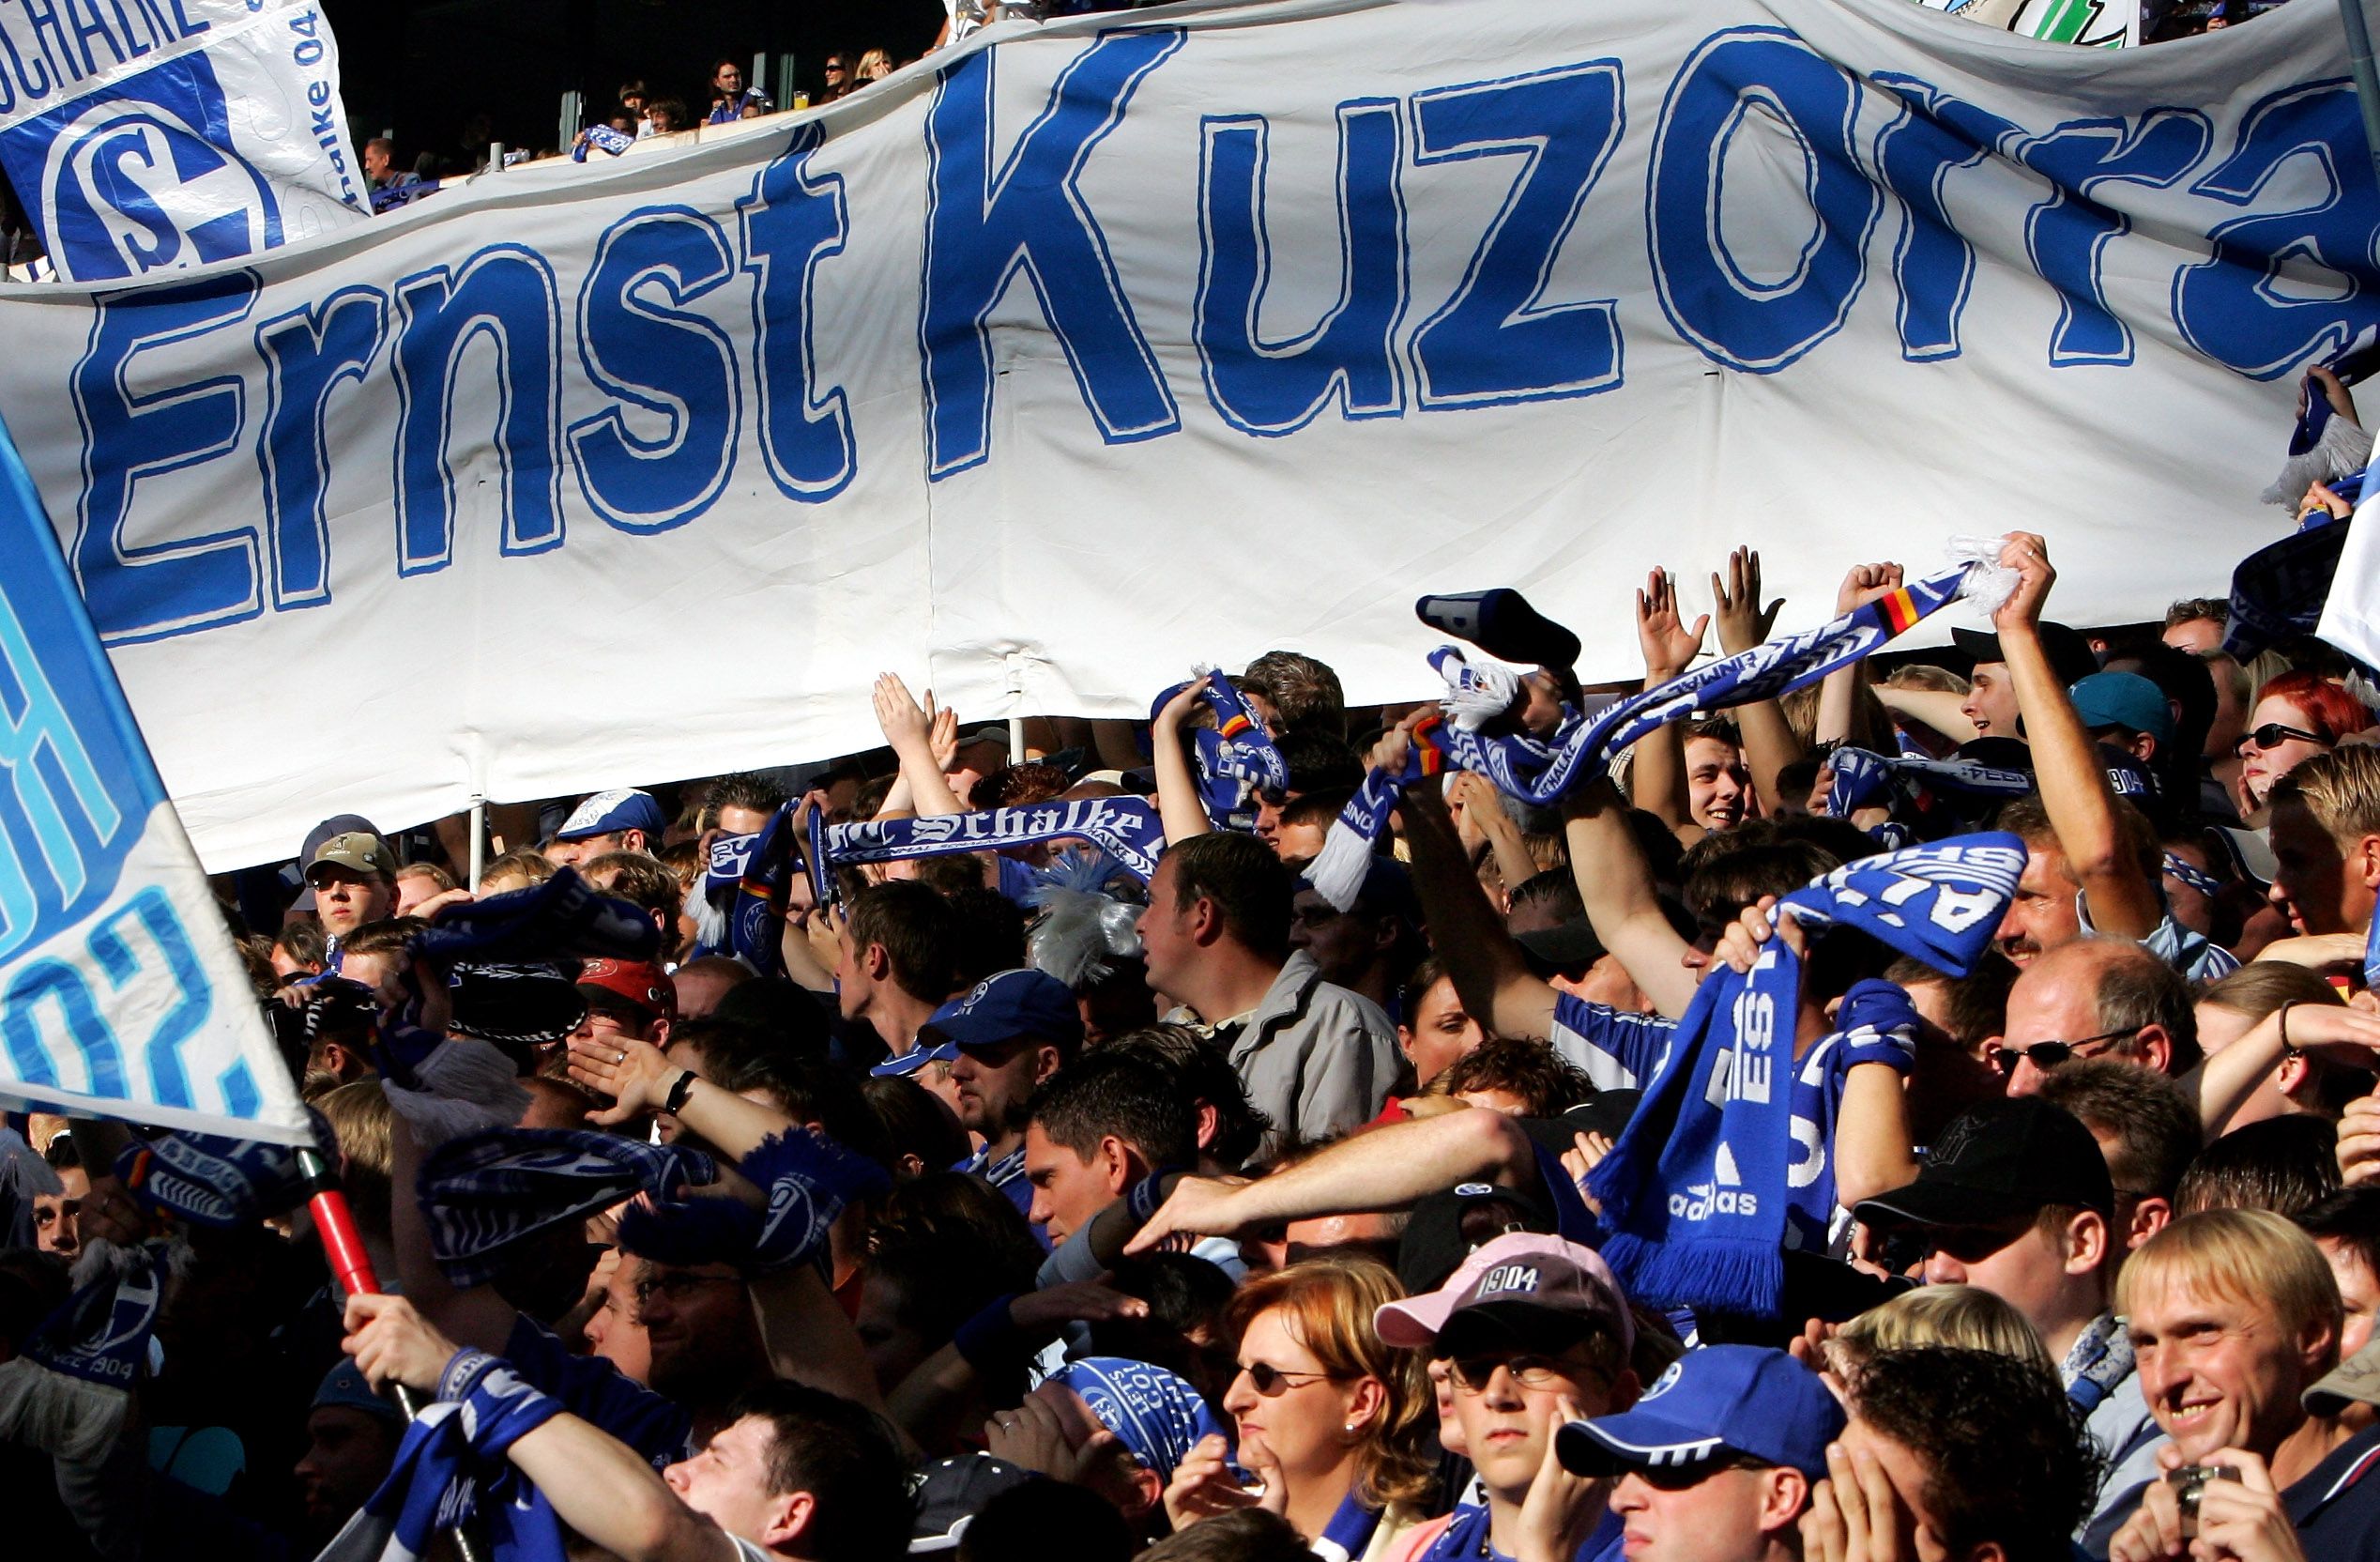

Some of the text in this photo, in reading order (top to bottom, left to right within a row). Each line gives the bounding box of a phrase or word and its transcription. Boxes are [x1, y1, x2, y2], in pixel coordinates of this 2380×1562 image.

[0, 0, 211, 114] CHAL
[289, 9, 372, 217] halke 04
[71, 24, 2380, 646] Ernst Kuzorra
[2106, 768, 2144, 794] 904
[910, 797, 1144, 844] Schalke
[1669, 1178, 1757, 1222] adas
[1475, 1265, 1540, 1299] 1904
